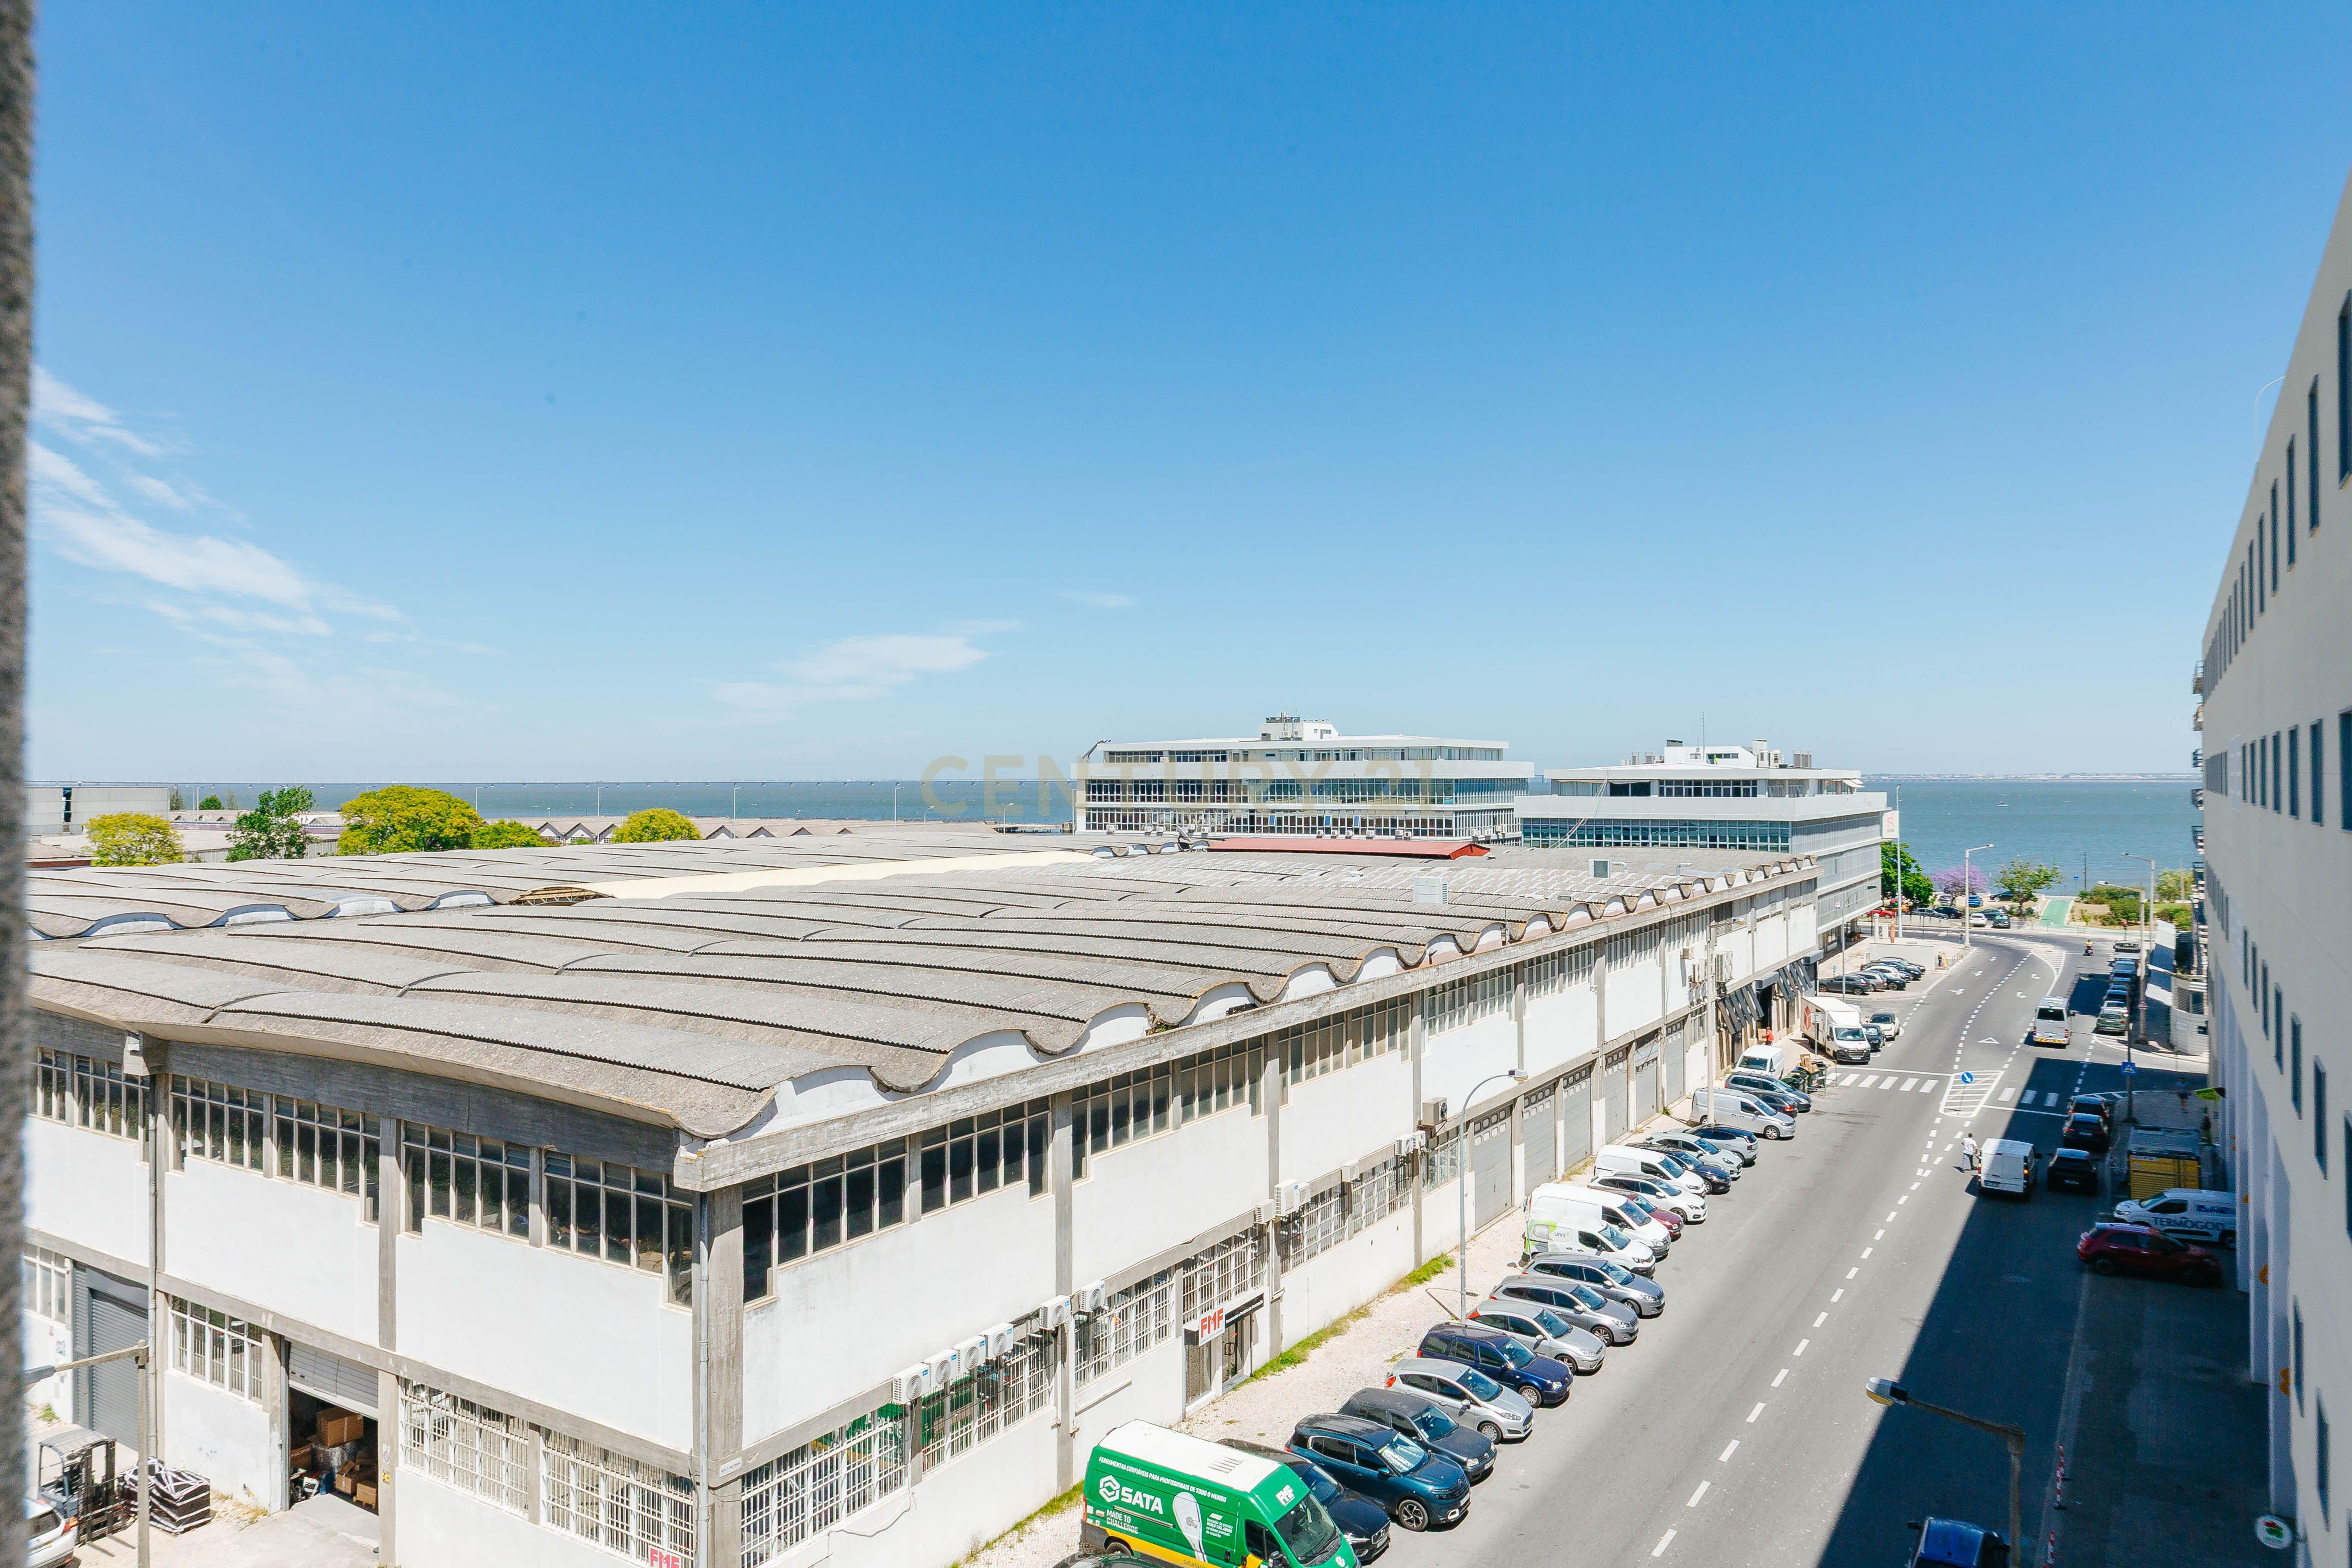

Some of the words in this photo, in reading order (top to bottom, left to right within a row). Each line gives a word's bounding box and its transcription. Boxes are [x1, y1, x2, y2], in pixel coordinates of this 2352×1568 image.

[1200, 1308, 1224, 1339] FMF
[1099, 1456, 1126, 1470] FERRAMENTAS
[1126, 1465, 1149, 1478] CONFIÁVEIS
[1149, 1473, 1159, 1481] PARA
[1160, 1476, 1190, 1491] PROFISSIONAIS
[1196, 1487, 1207, 1496] TODO
[1211, 1493, 1227, 1503] MUNDO
[1121, 1486, 1163, 1515] SATA
[1106, 1509, 1122, 1519] MADE
[1124, 1514, 1131, 1524] TO
[1106, 1517, 1138, 1534] CHALLENGE
